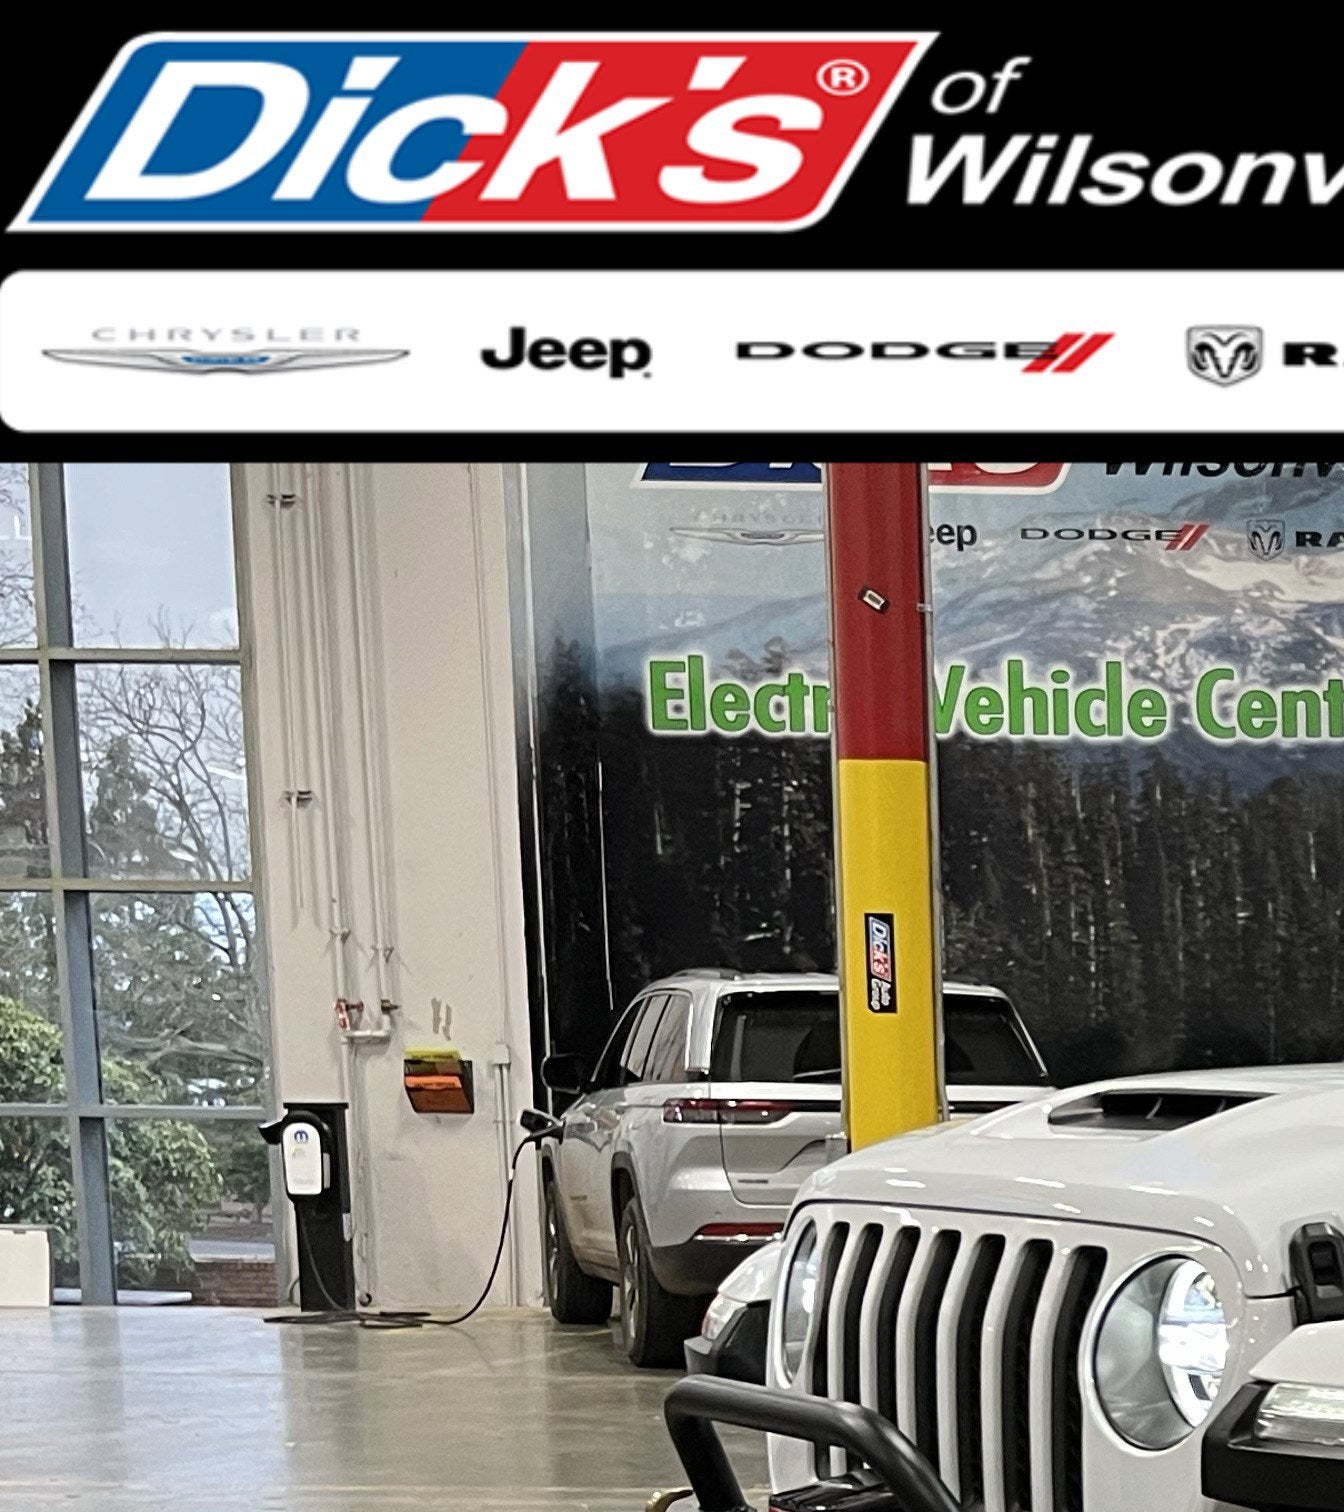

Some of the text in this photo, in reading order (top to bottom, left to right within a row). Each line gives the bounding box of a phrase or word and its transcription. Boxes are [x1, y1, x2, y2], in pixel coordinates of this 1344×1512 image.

[929, 523, 978, 552] ep
[1020, 527, 1183, 542] DODGE
[649, 654, 830, 732] Electr
[932, 659, 1168, 737] Vehicle
